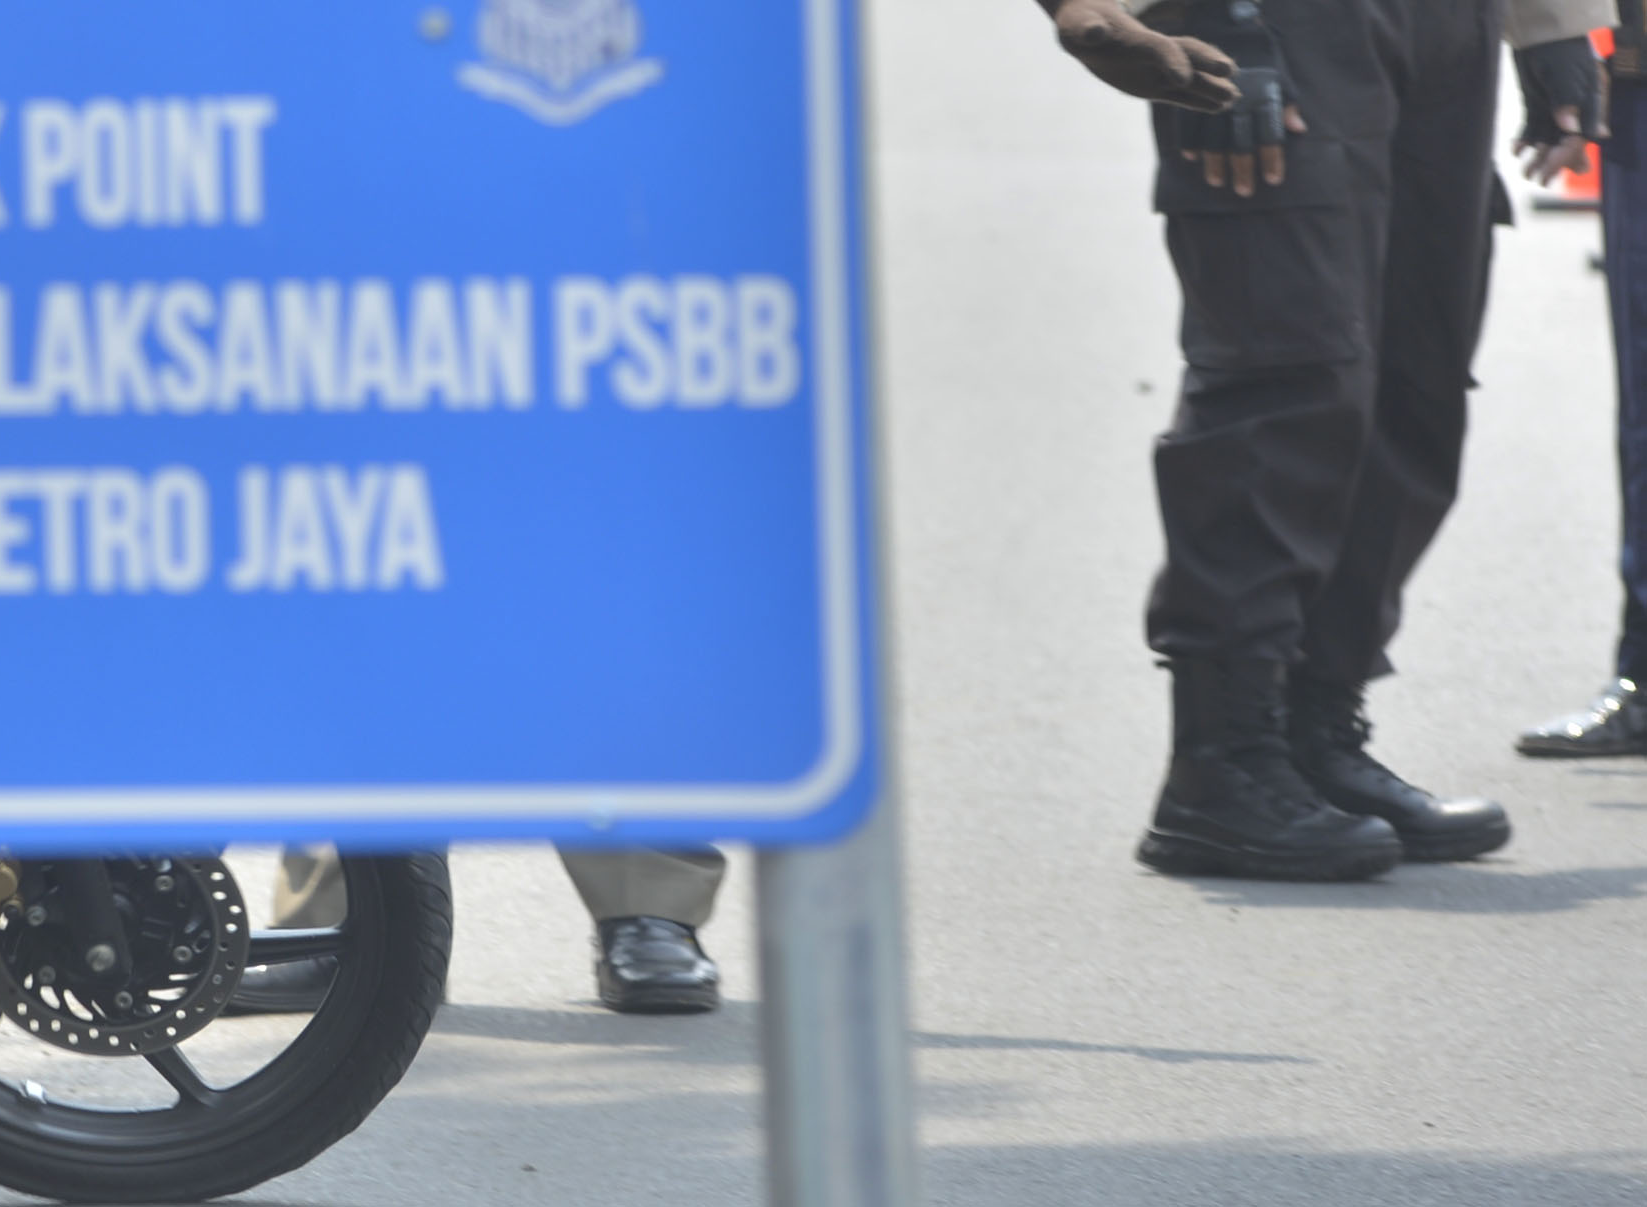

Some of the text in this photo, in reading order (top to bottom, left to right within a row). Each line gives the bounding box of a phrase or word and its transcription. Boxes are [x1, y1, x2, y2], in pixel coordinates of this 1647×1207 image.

[23, 94, 277, 228] POINT
[554, 274, 803, 409] PSBB
[227, 462, 445, 591] JAYA
